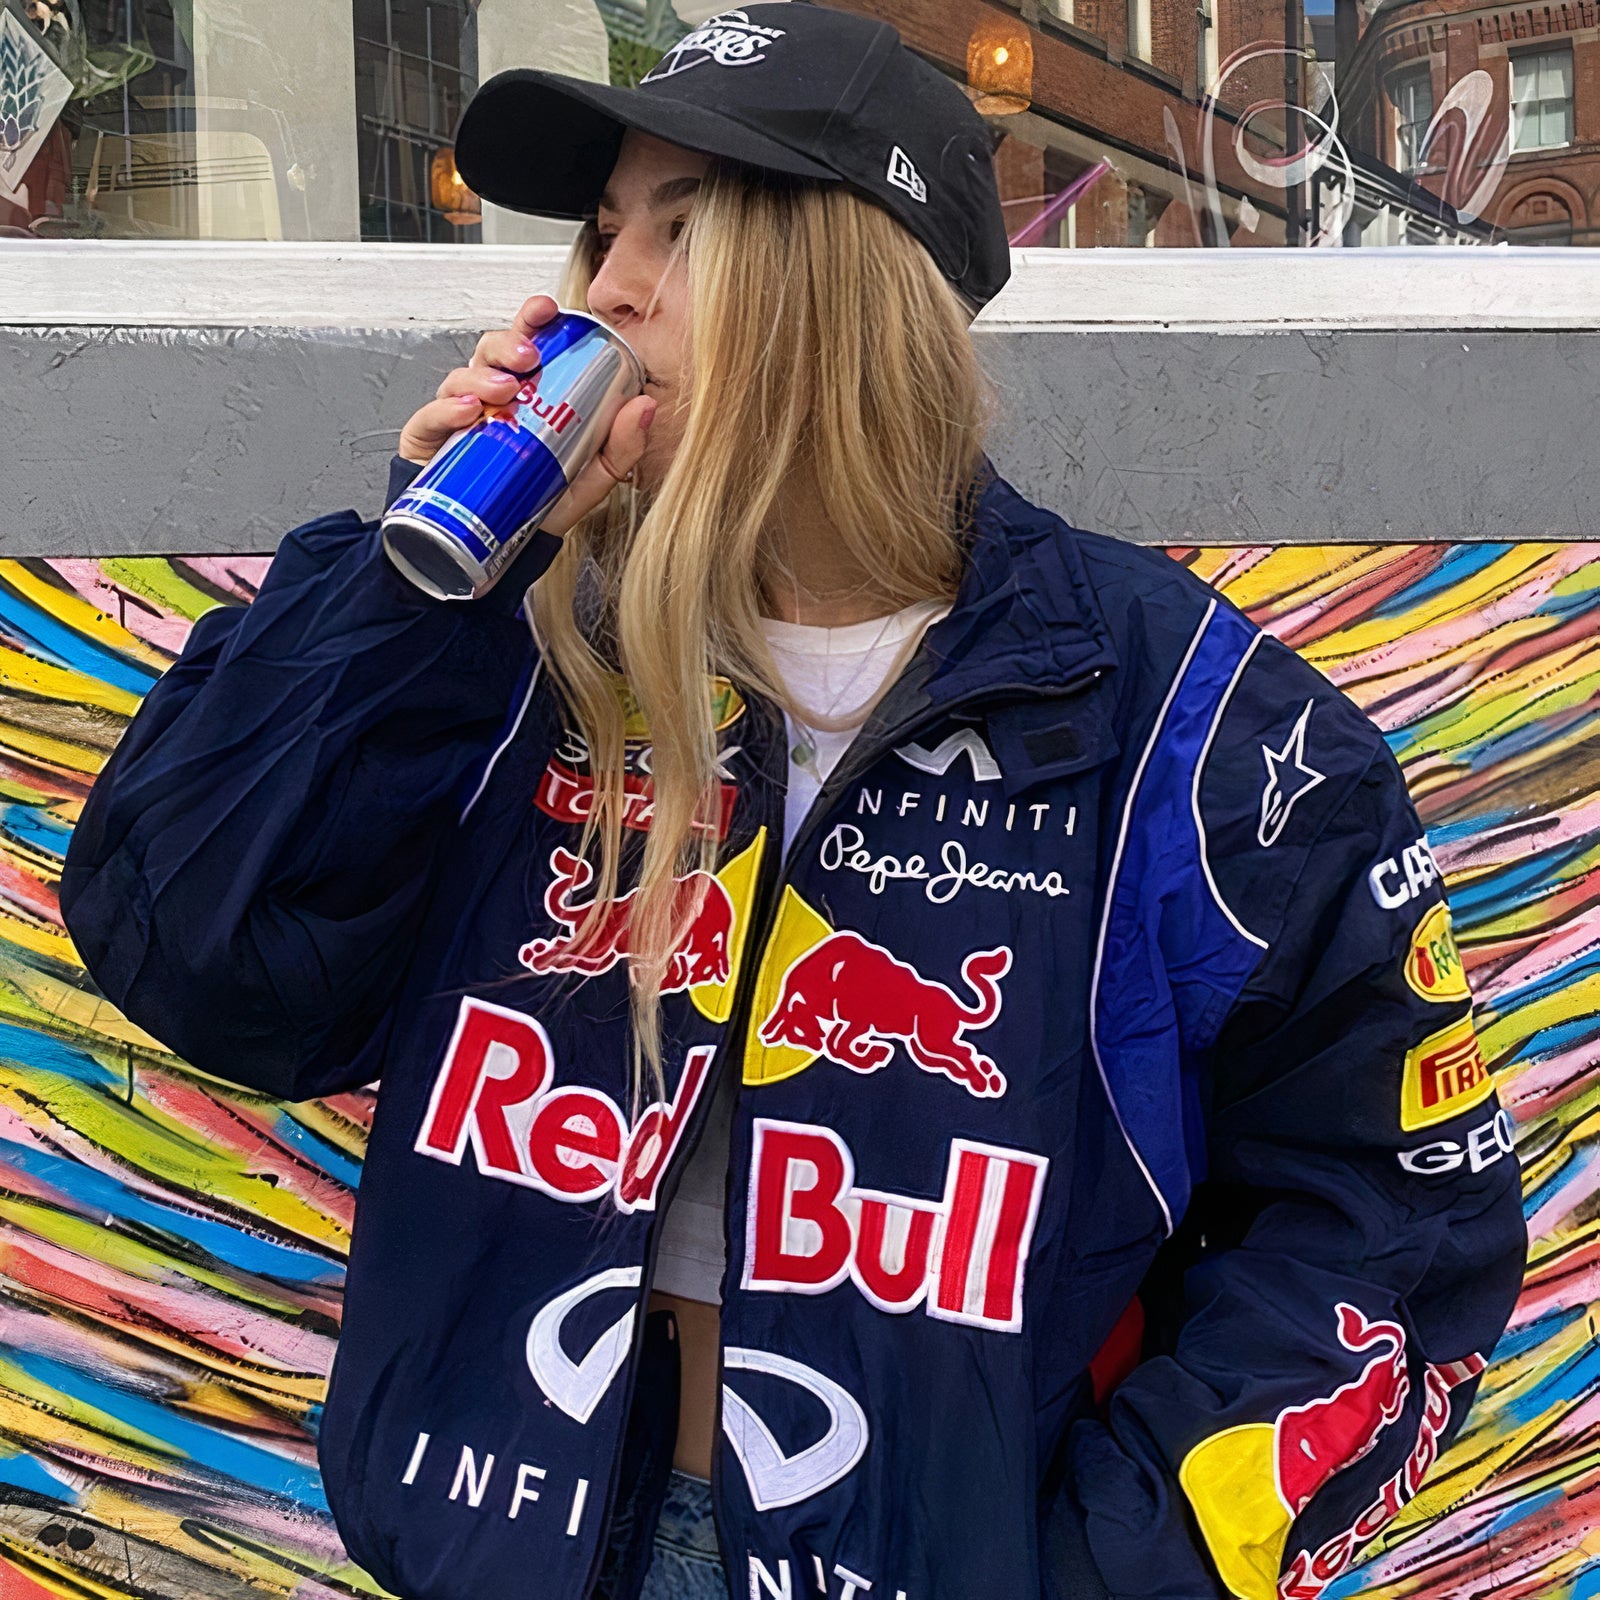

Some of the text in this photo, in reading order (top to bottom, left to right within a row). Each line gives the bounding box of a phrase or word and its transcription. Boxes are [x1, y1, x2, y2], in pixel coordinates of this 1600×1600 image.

[819, 823, 1070, 904] Pepe Jeans
[414, 995, 1050, 1334] Red Bull
[401, 1432, 907, 1600] INFI NIT
